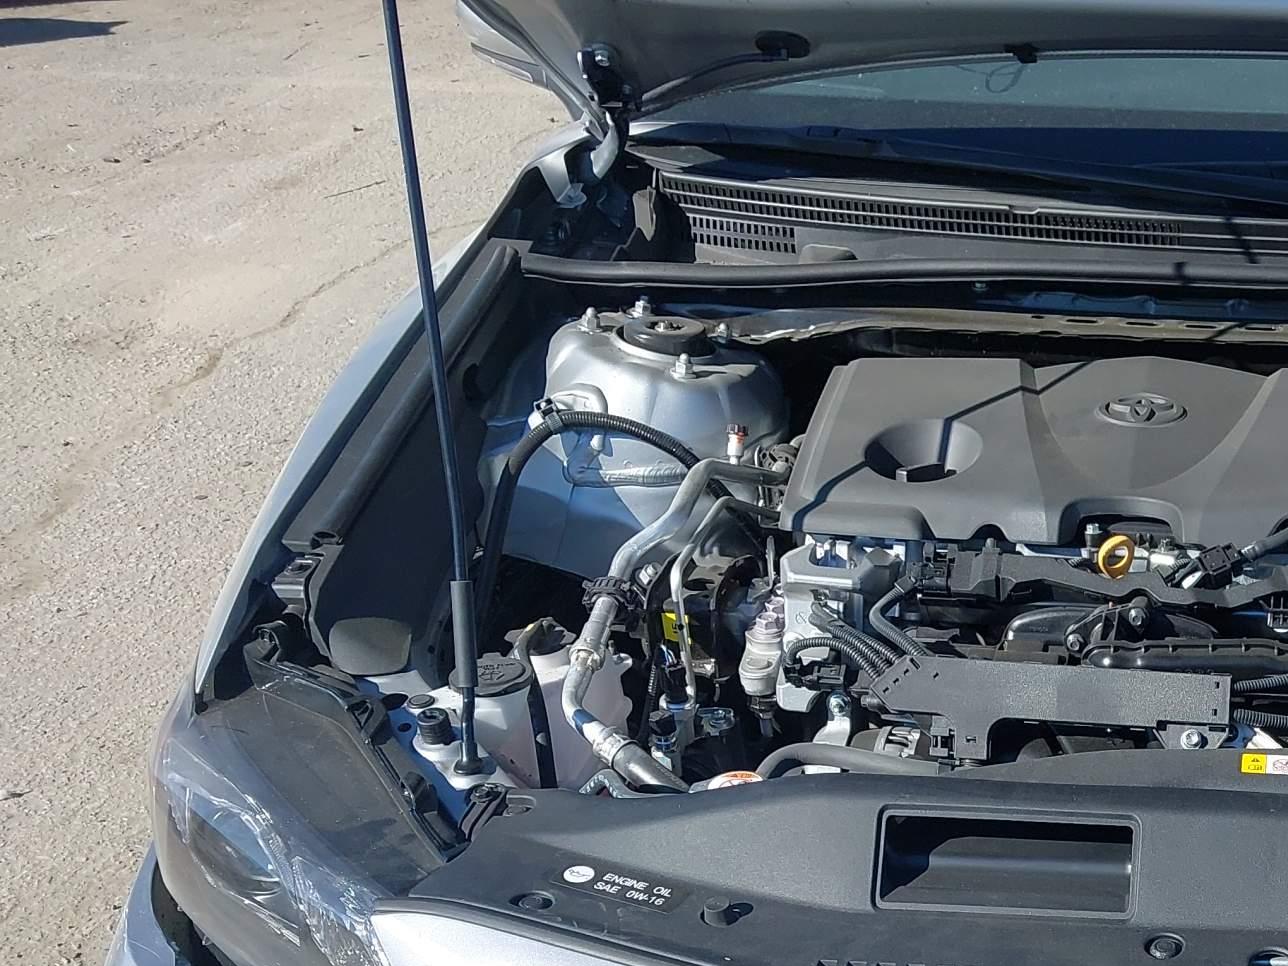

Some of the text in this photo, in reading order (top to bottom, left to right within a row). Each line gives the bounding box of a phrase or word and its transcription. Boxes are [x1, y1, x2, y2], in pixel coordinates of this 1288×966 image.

[593, 881, 665, 906] SAE 0W-16
[602, 872, 673, 898] ENGINE OIL
